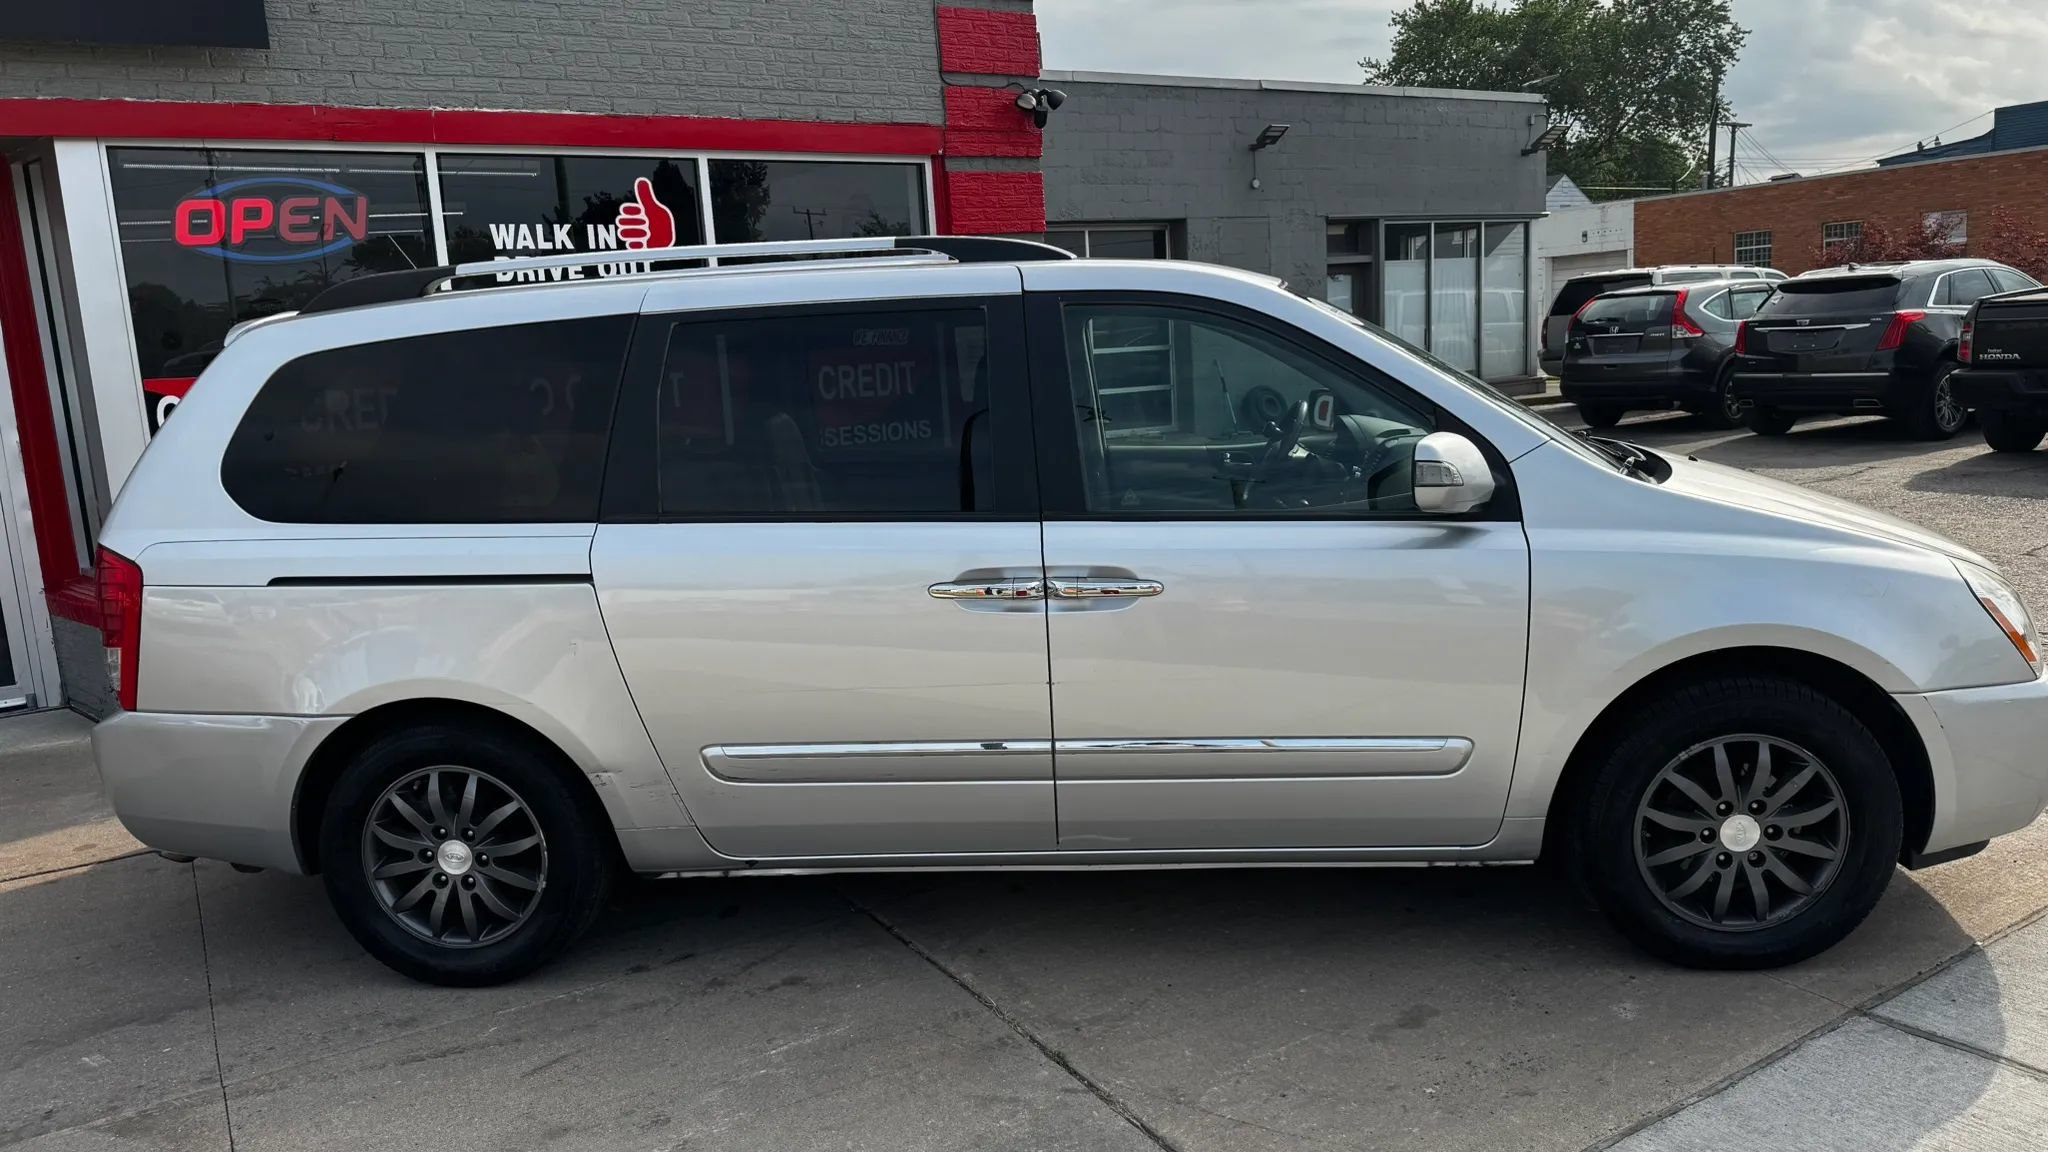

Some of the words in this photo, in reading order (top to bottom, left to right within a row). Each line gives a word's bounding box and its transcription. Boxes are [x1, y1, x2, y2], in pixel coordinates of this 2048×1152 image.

[175, 197, 369, 246] OPEN
[489, 223, 575, 250] WALK
[586, 223, 618, 250] IN
[818, 360, 916, 401] CREDIT
